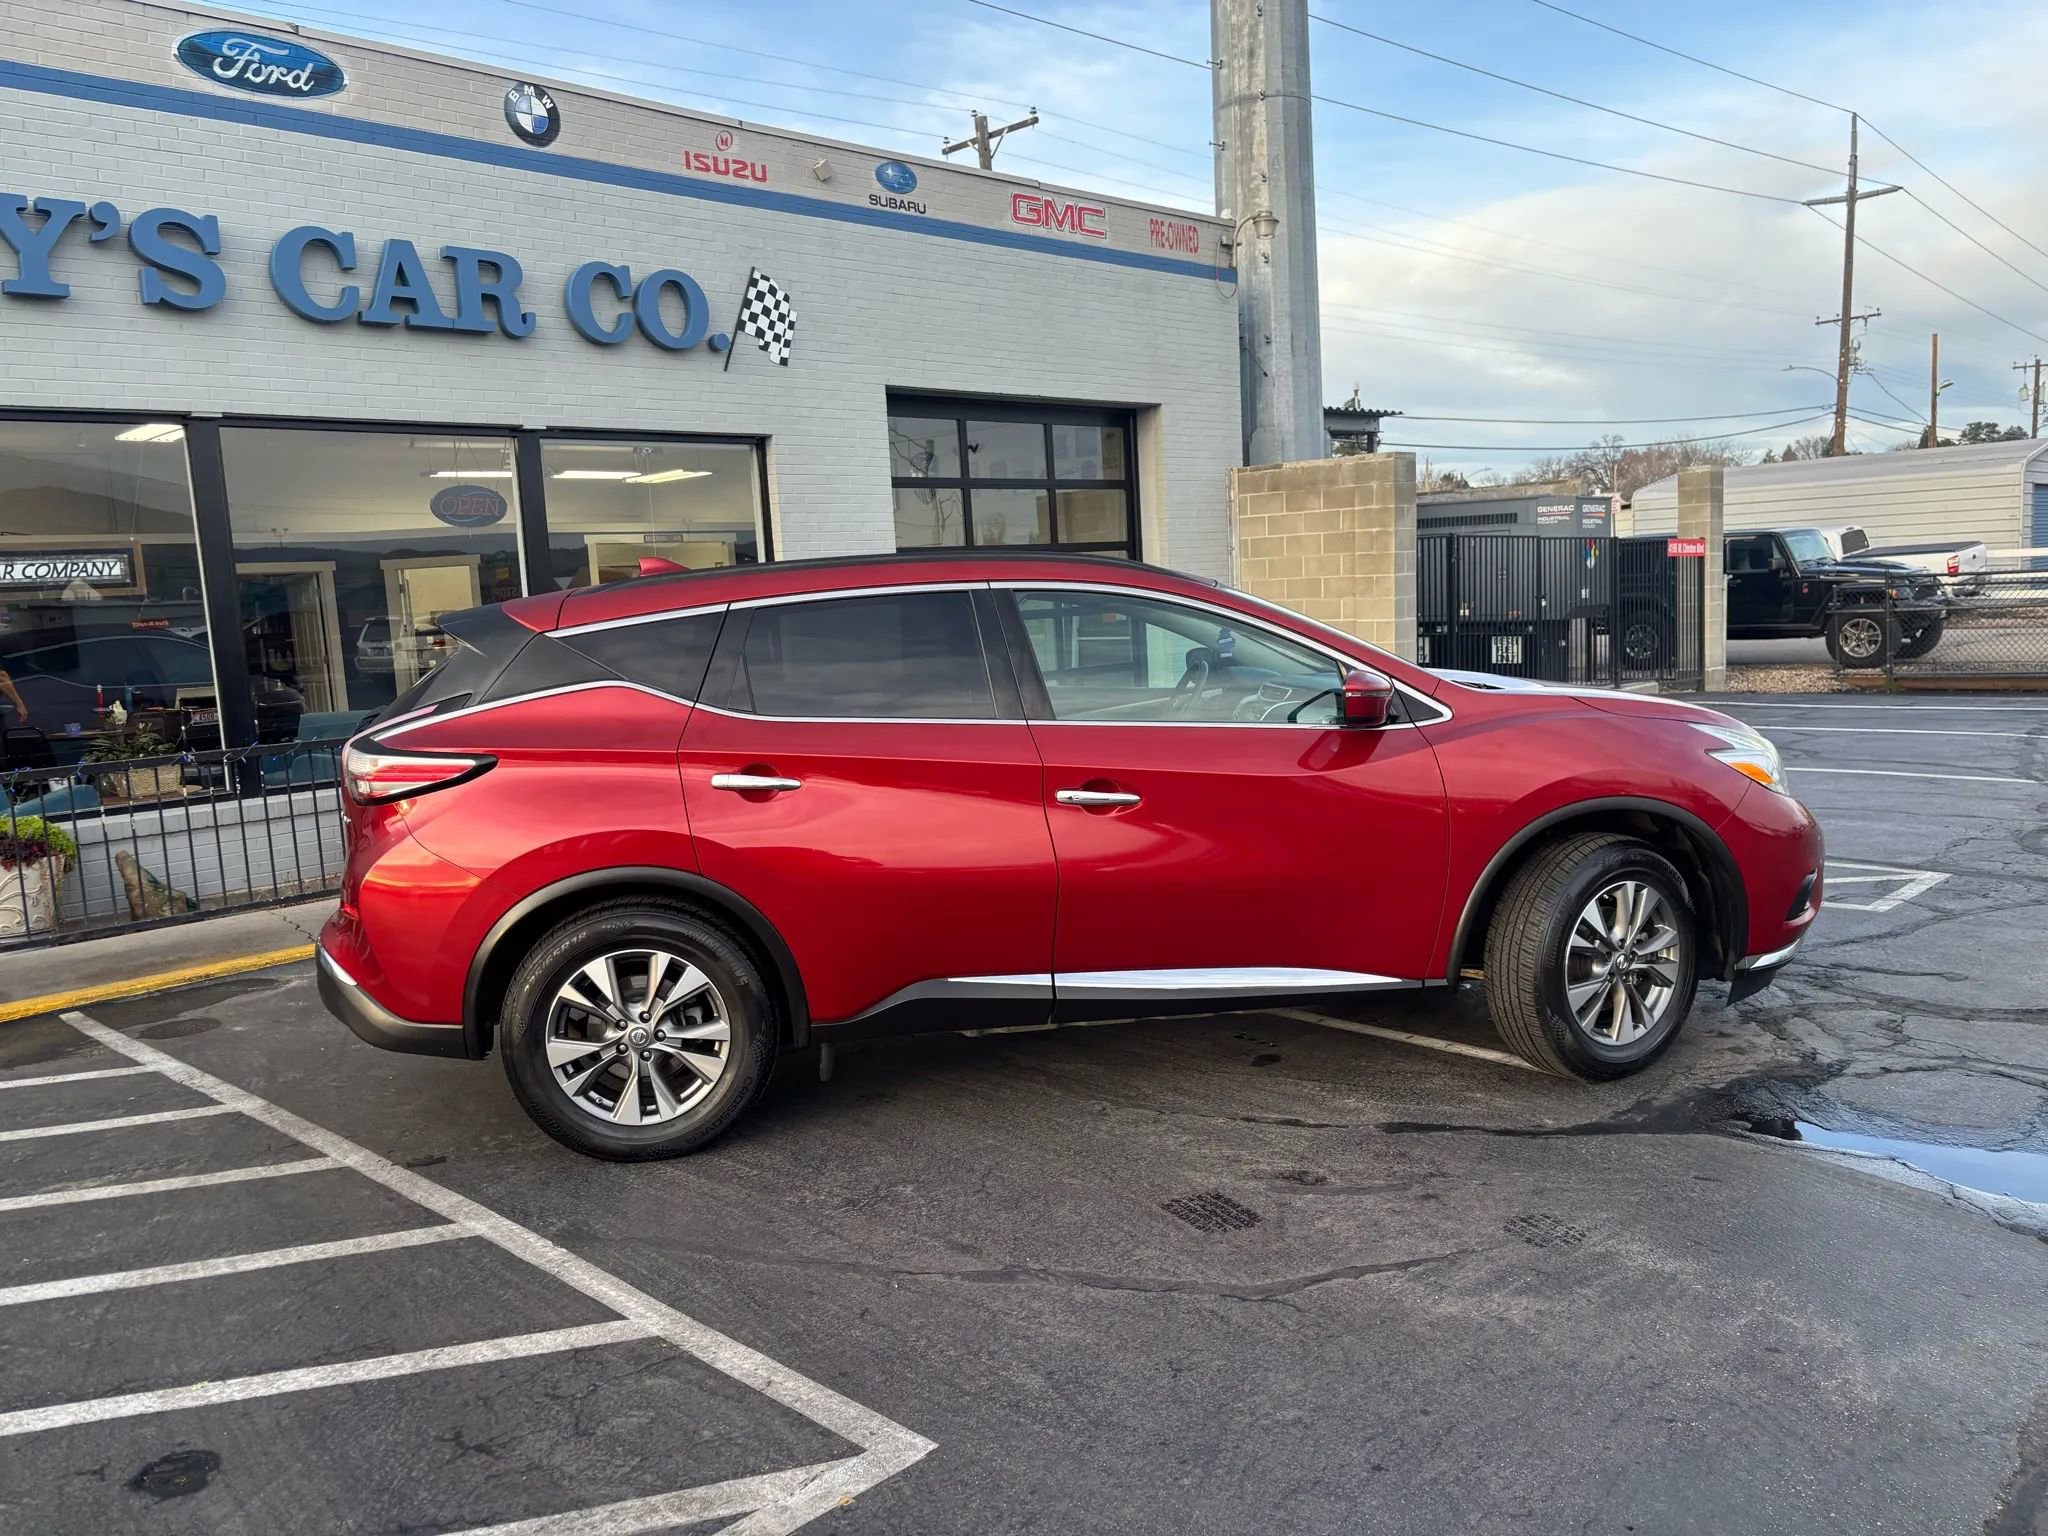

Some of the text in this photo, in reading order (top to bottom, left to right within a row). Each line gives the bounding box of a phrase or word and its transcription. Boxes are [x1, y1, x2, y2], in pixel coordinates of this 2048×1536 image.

[212, 37, 315, 92] Ford
[508, 84, 555, 110] BMW
[683, 150, 767, 183] ISUZU
[868, 193, 927, 214] SUBARU
[1010, 191, 1107, 239] GMC
[1149, 217, 1200, 254] PRE-OWNED
[268, 225, 536, 339] CAR
[565, 260, 730, 351] CO.
[440, 496, 500, 516] OPEN
[1537, 504, 1575, 513] GENERAC
[0, 561, 118, 580] R COMPANY
[687, 1075, 754, 1145] CROSSOVER
